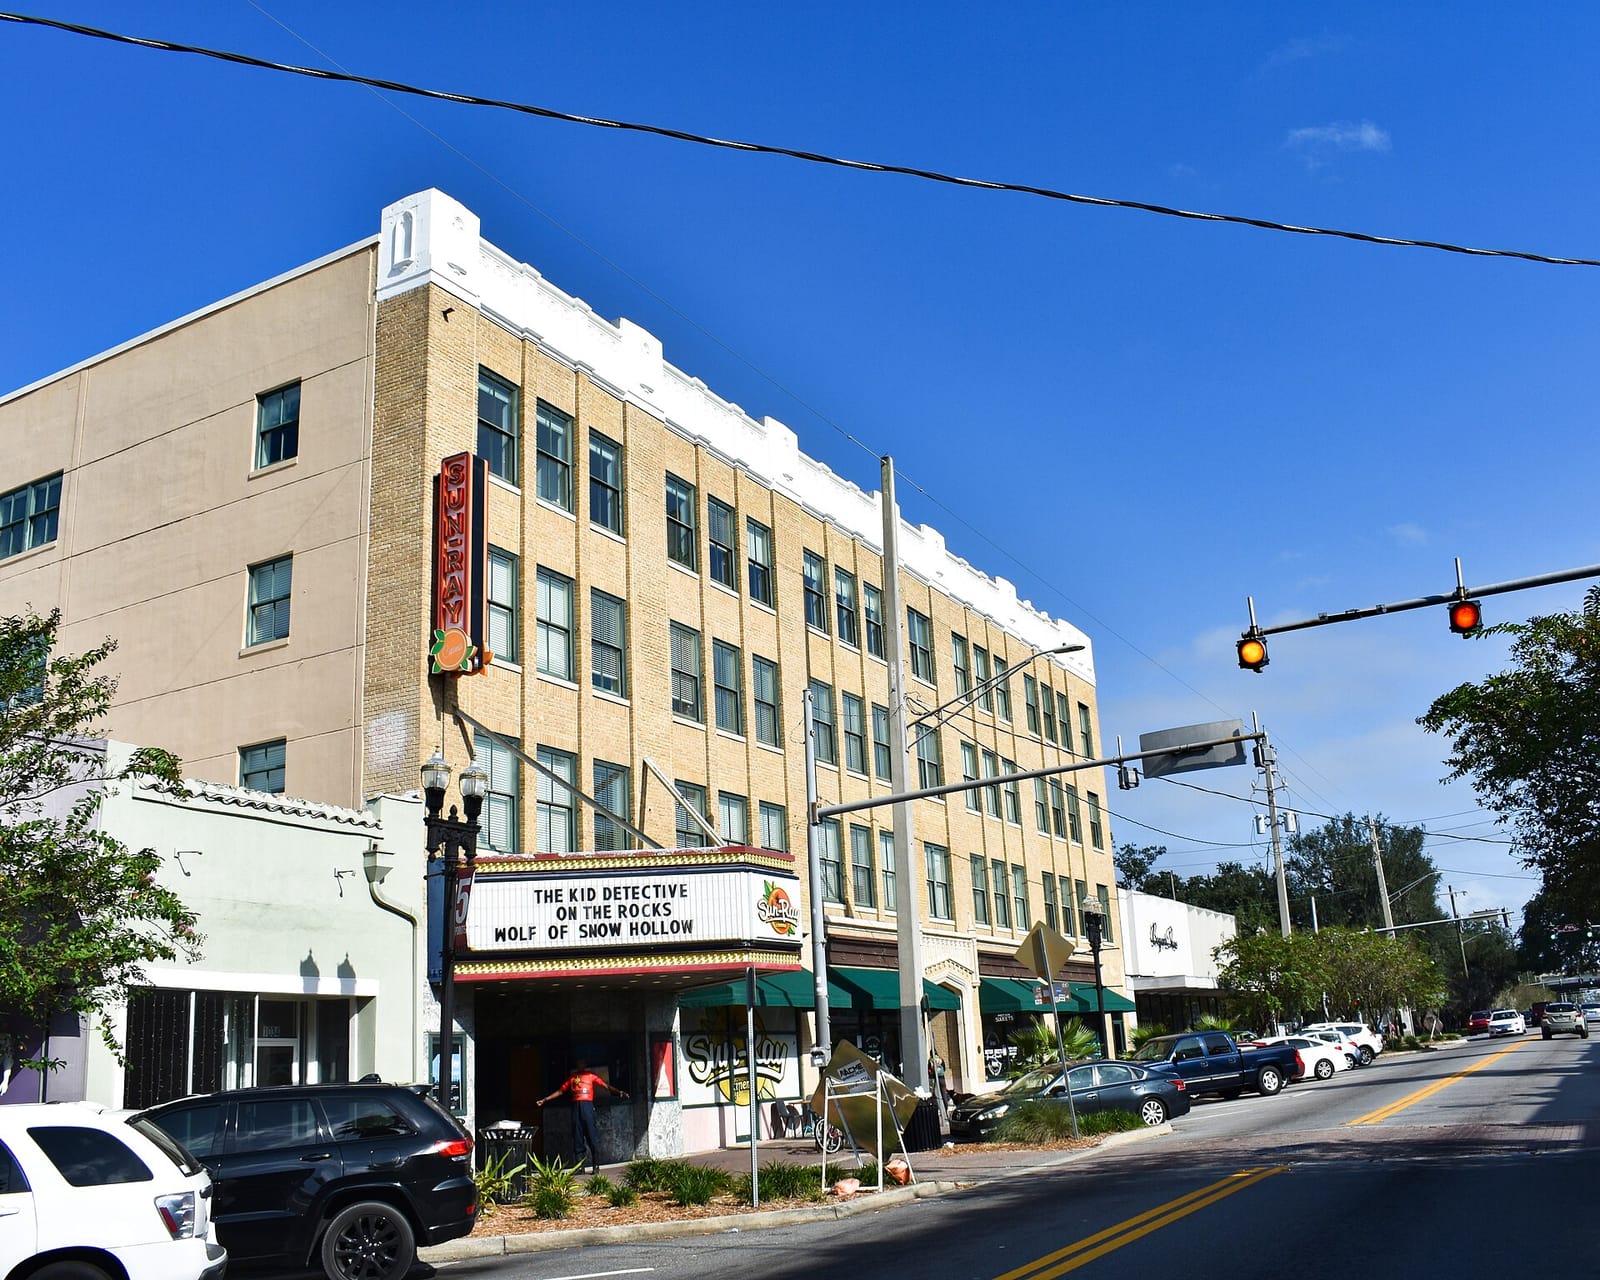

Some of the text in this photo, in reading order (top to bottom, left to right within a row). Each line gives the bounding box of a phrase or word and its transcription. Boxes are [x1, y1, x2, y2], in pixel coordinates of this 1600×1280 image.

[444, 463, 465, 625] SUN-RAY
[534, 883, 688, 905] THE KID DETECTIVE
[556, 902, 672, 921] ON THE ROCKS
[494, 919, 693, 943] WOLF OF SNOW HOLLOW
